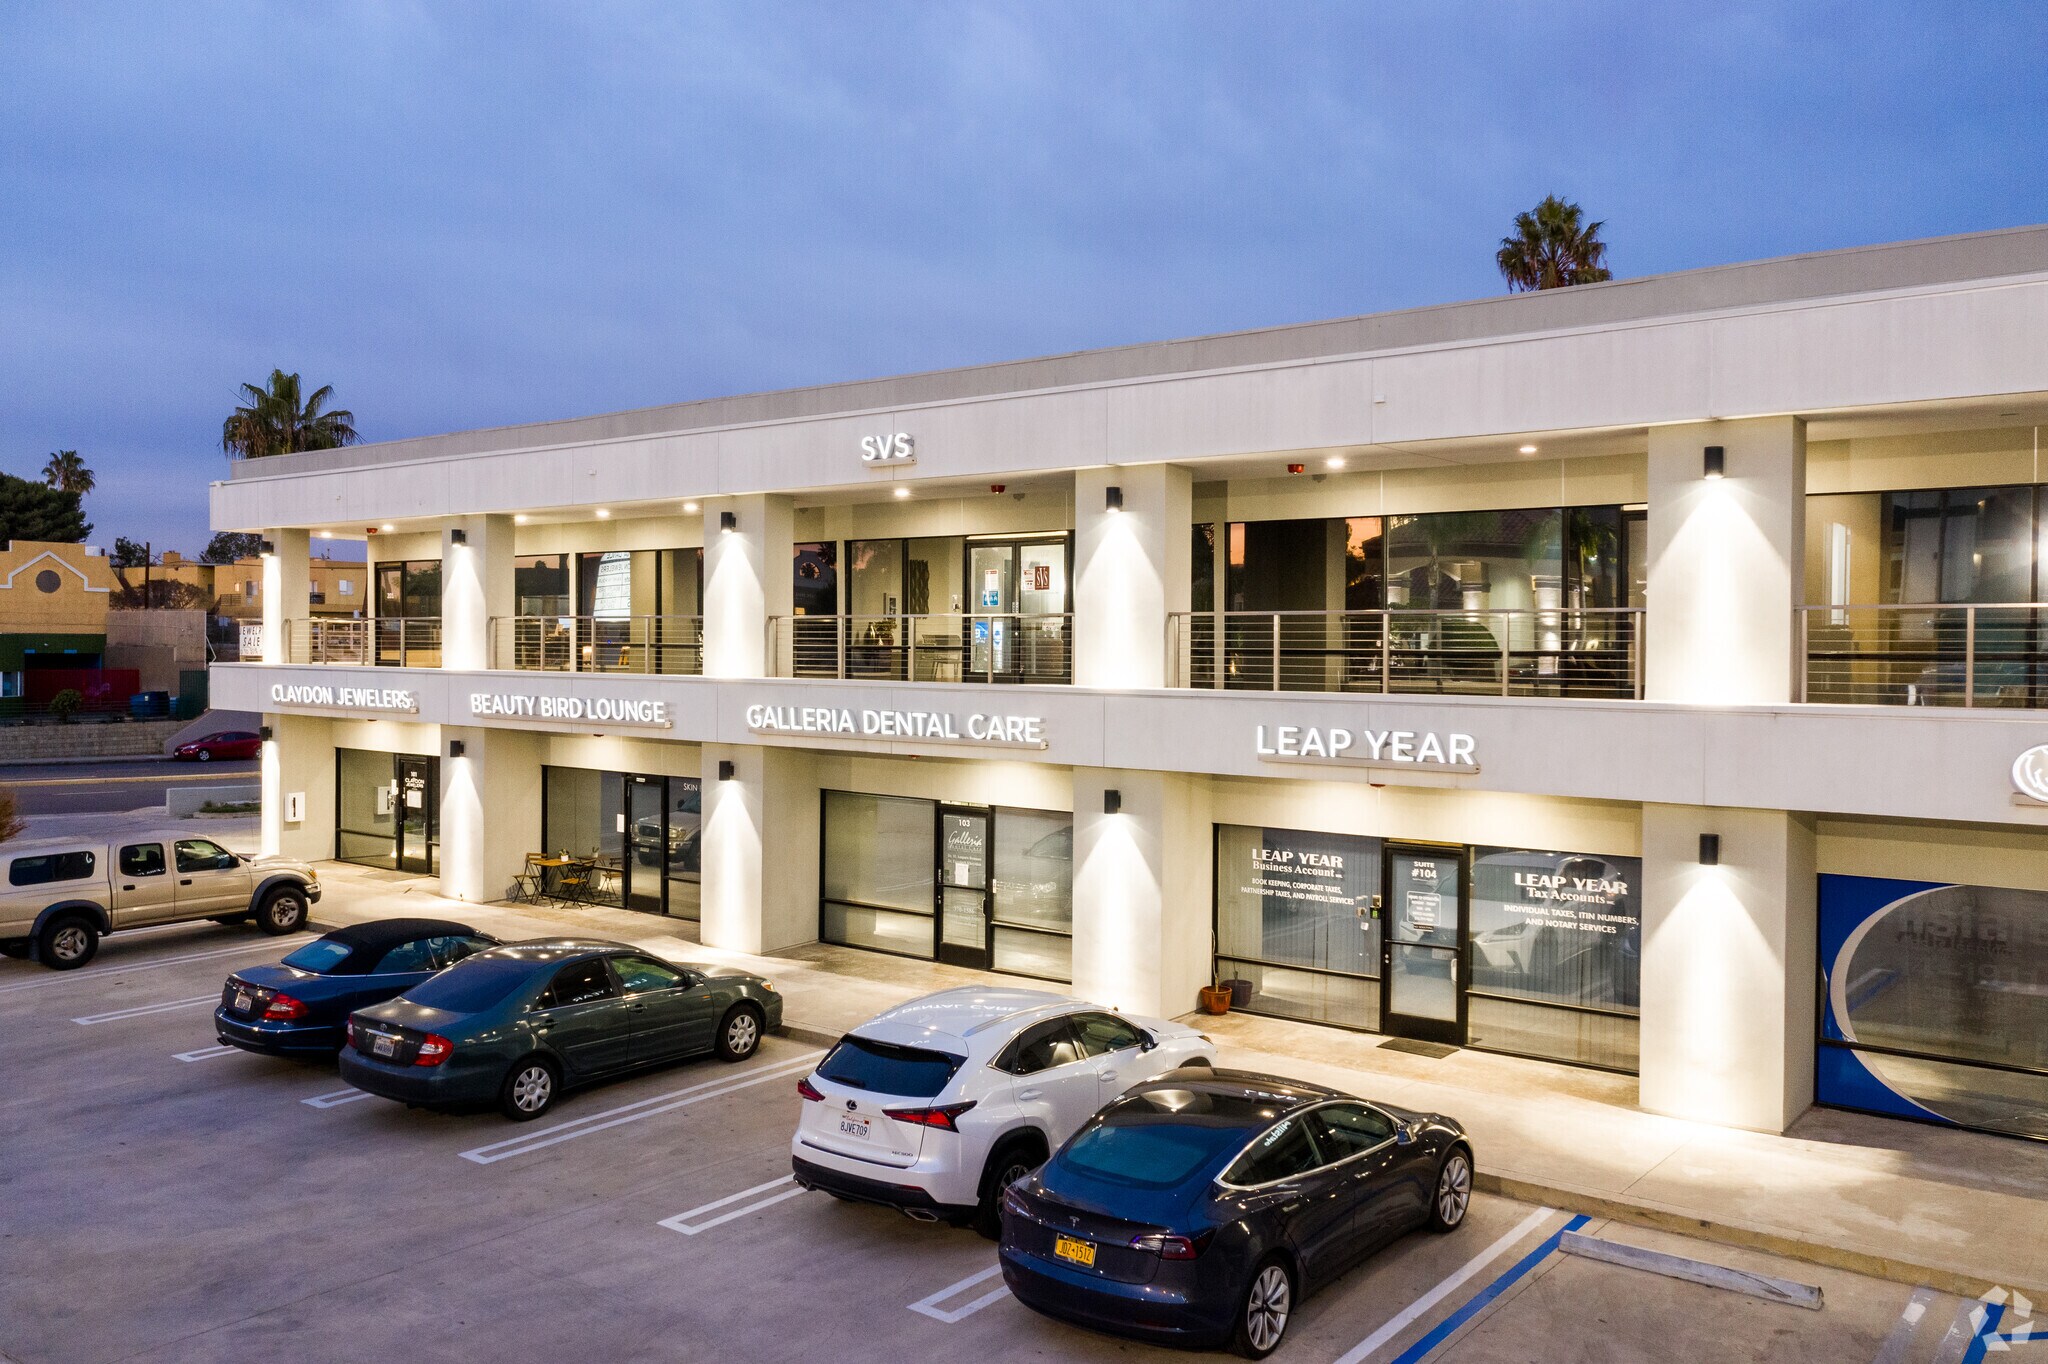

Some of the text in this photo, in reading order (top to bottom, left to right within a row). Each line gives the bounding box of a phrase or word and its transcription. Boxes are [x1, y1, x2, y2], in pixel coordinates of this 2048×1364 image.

[861, 432, 912, 461] SVS
[1036, 567, 1049, 589] SVS
[243, 636, 260, 647] SALE
[271, 683, 412, 709] CLAYDON JEWELERS
[470, 693, 665, 723] BEAUTY BIRD LOUNGE
[746, 704, 1041, 743] GALLERIA DENTAL CARE
[1256, 725, 1476, 765] LEAP YEAR
[683, 782, 698, 791] SKIN
[959, 819, 970, 827] 103
[948, 830, 982, 848] Galleria
[1251, 848, 1343, 868] LEAP YEAR
[1413, 861, 1435, 869] SUITE
[1252, 860, 1335, 877] Business Account
[1411, 868, 1437, 879] #104
[1268, 879, 1292, 889] KEEPING,
[1292, 882, 1324, 892] CORPORATE
[1325, 885, 1343, 895] TAXES,
[1514, 872, 1628, 895] LEAP YEAR
[1241, 886, 1355, 905] PARTNERSHIP TAXES, AND PAYROLL SERVICES
[1526, 887, 1548, 899] Tax
[1550, 889, 1606, 904] Accounts
[1503, 904, 1640, 926] INDIVIDUAL TAXES, ITIN NUMBERS,
[1525, 917, 1617, 934] AND NOTARY SERVICES
[840, 1121, 868, 1137] 8JVE709
